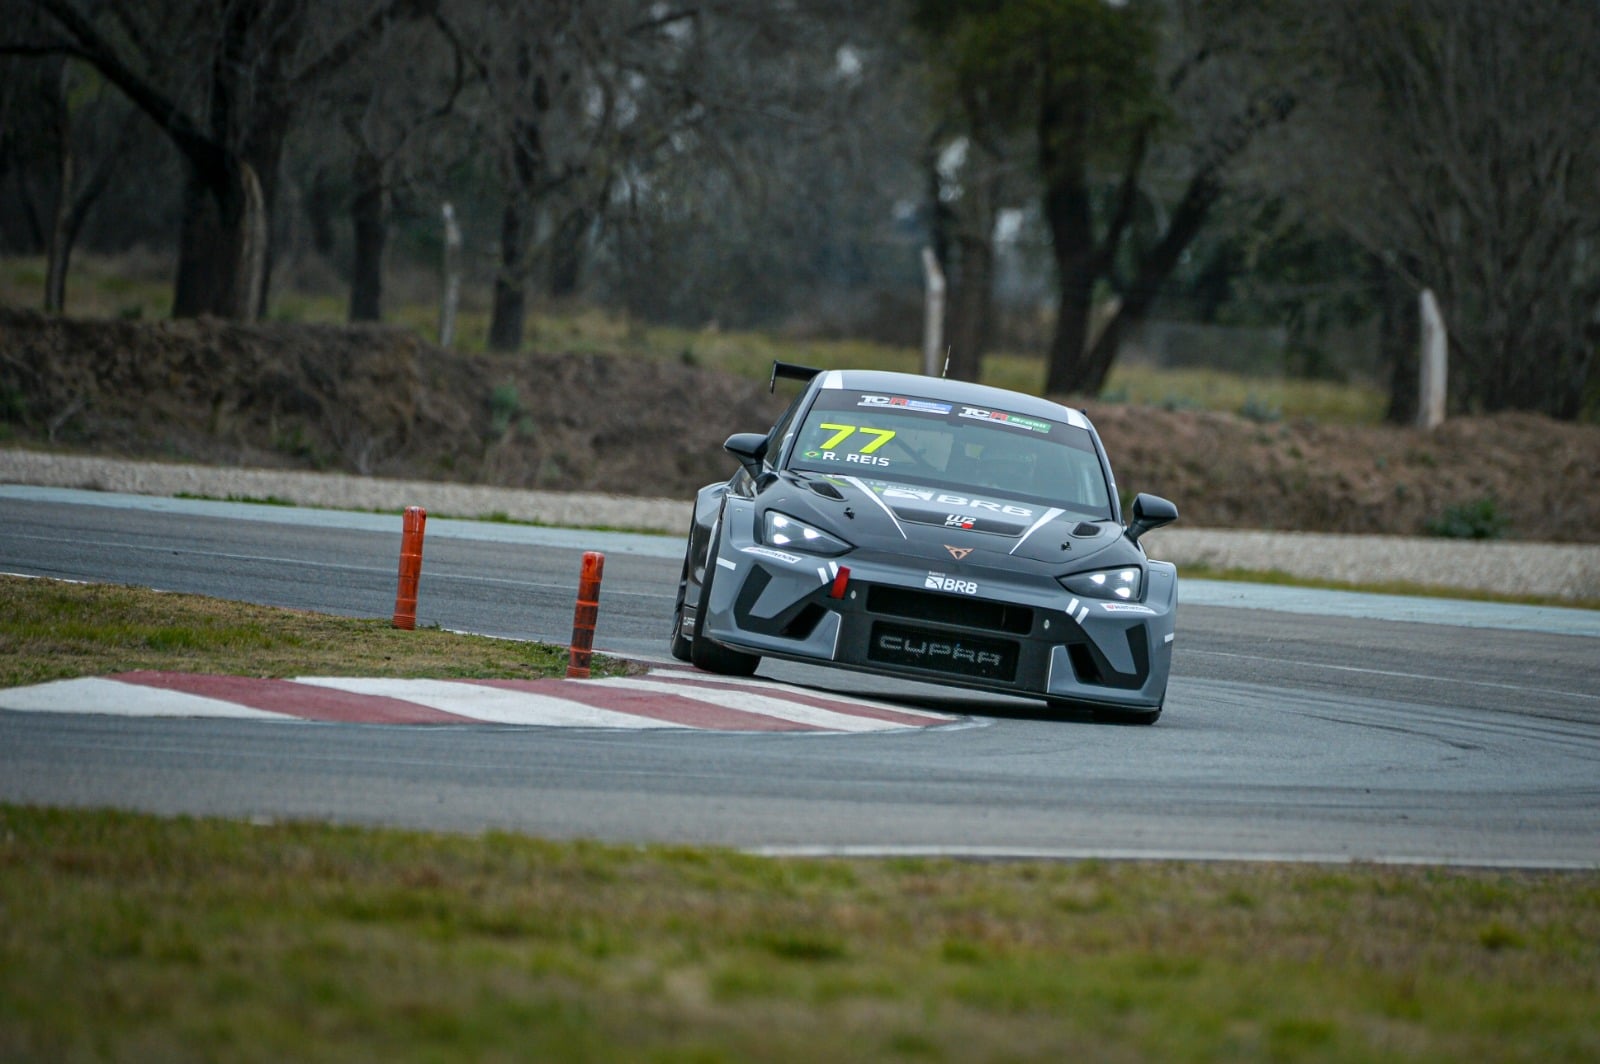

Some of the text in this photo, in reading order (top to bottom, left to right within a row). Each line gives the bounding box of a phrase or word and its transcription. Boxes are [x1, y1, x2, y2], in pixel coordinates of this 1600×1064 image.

[861, 395, 908, 406] TCR
[961, 407, 1008, 421] TCR
[820, 423, 897, 454] 77
[822, 451, 891, 467] R. REIS
[936, 495, 1033, 517] BRB
[943, 578, 978, 595] BRB
[879, 635, 1002, 666] CUPRA
